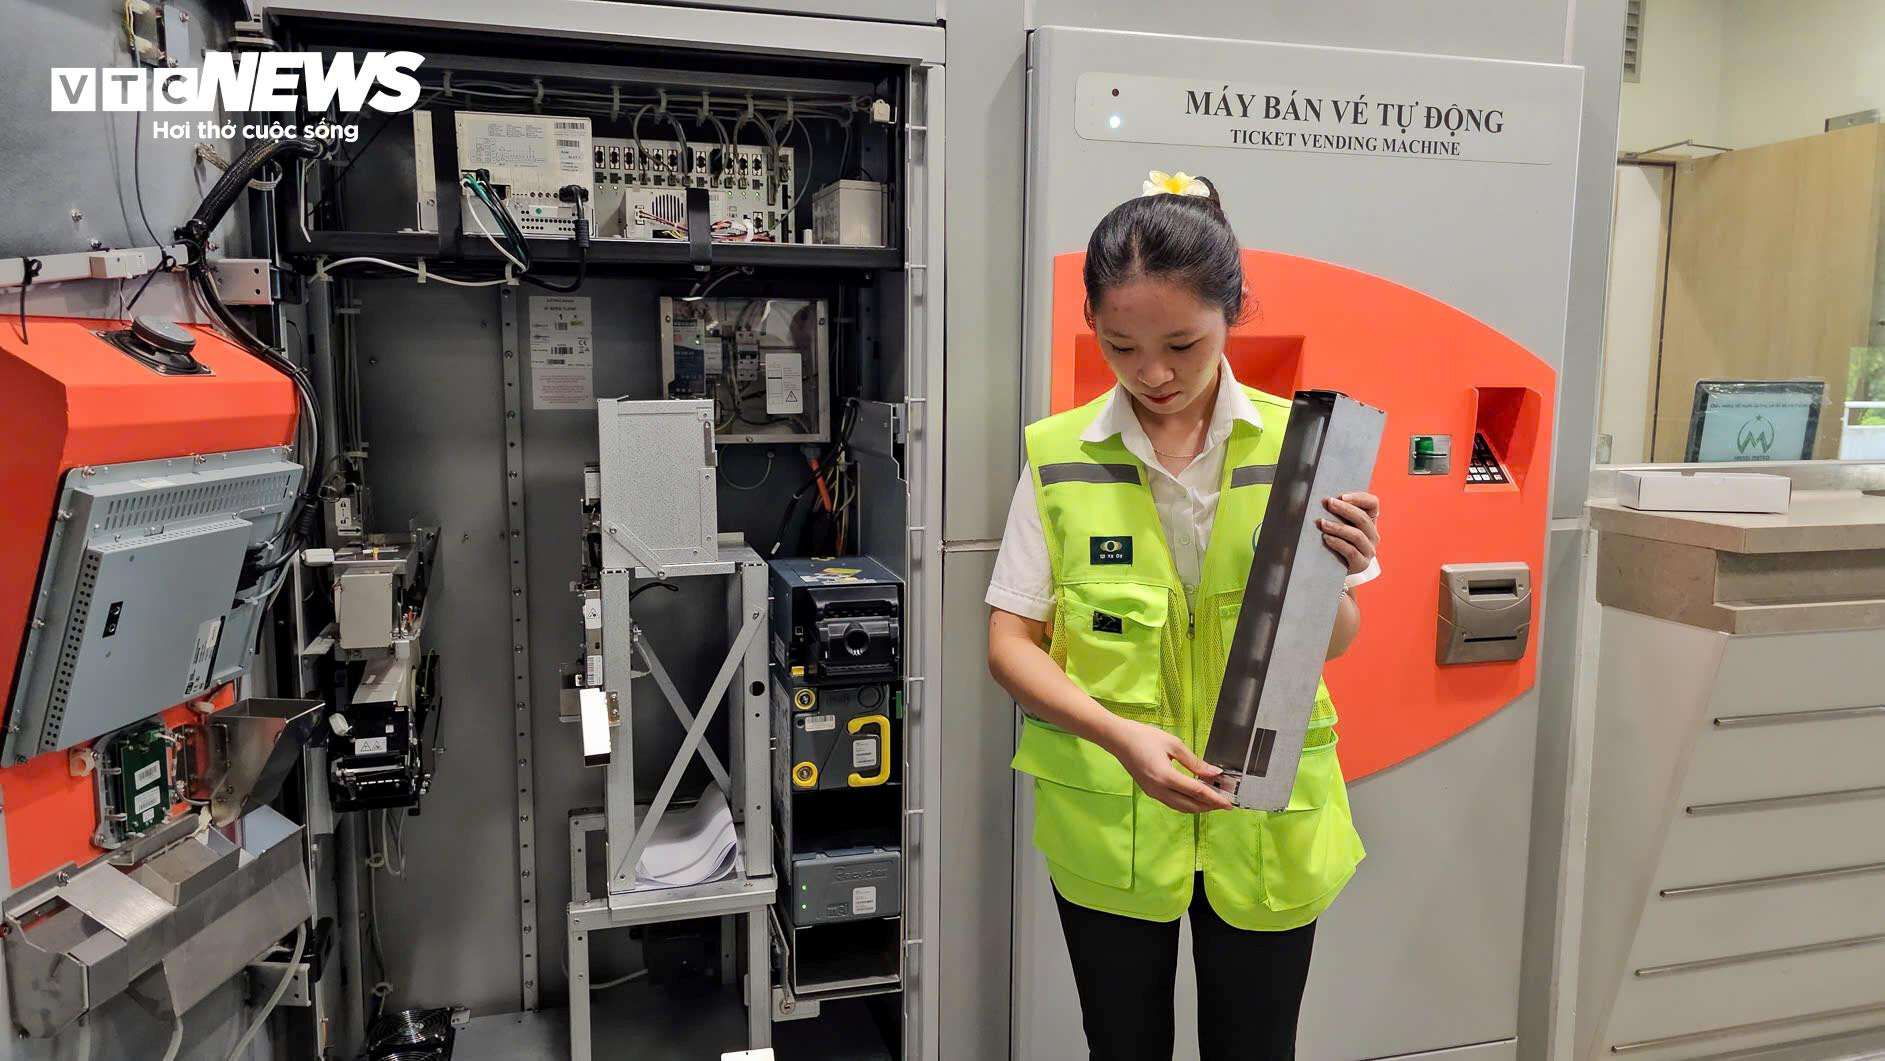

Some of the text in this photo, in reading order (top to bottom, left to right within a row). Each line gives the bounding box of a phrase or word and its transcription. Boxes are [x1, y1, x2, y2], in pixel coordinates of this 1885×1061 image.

[1185, 85, 1505, 137] MÁY BÁN VÉ TỰ ĐỘNG
[1230, 129, 1461, 156] TICKET VENDING MACHINE
